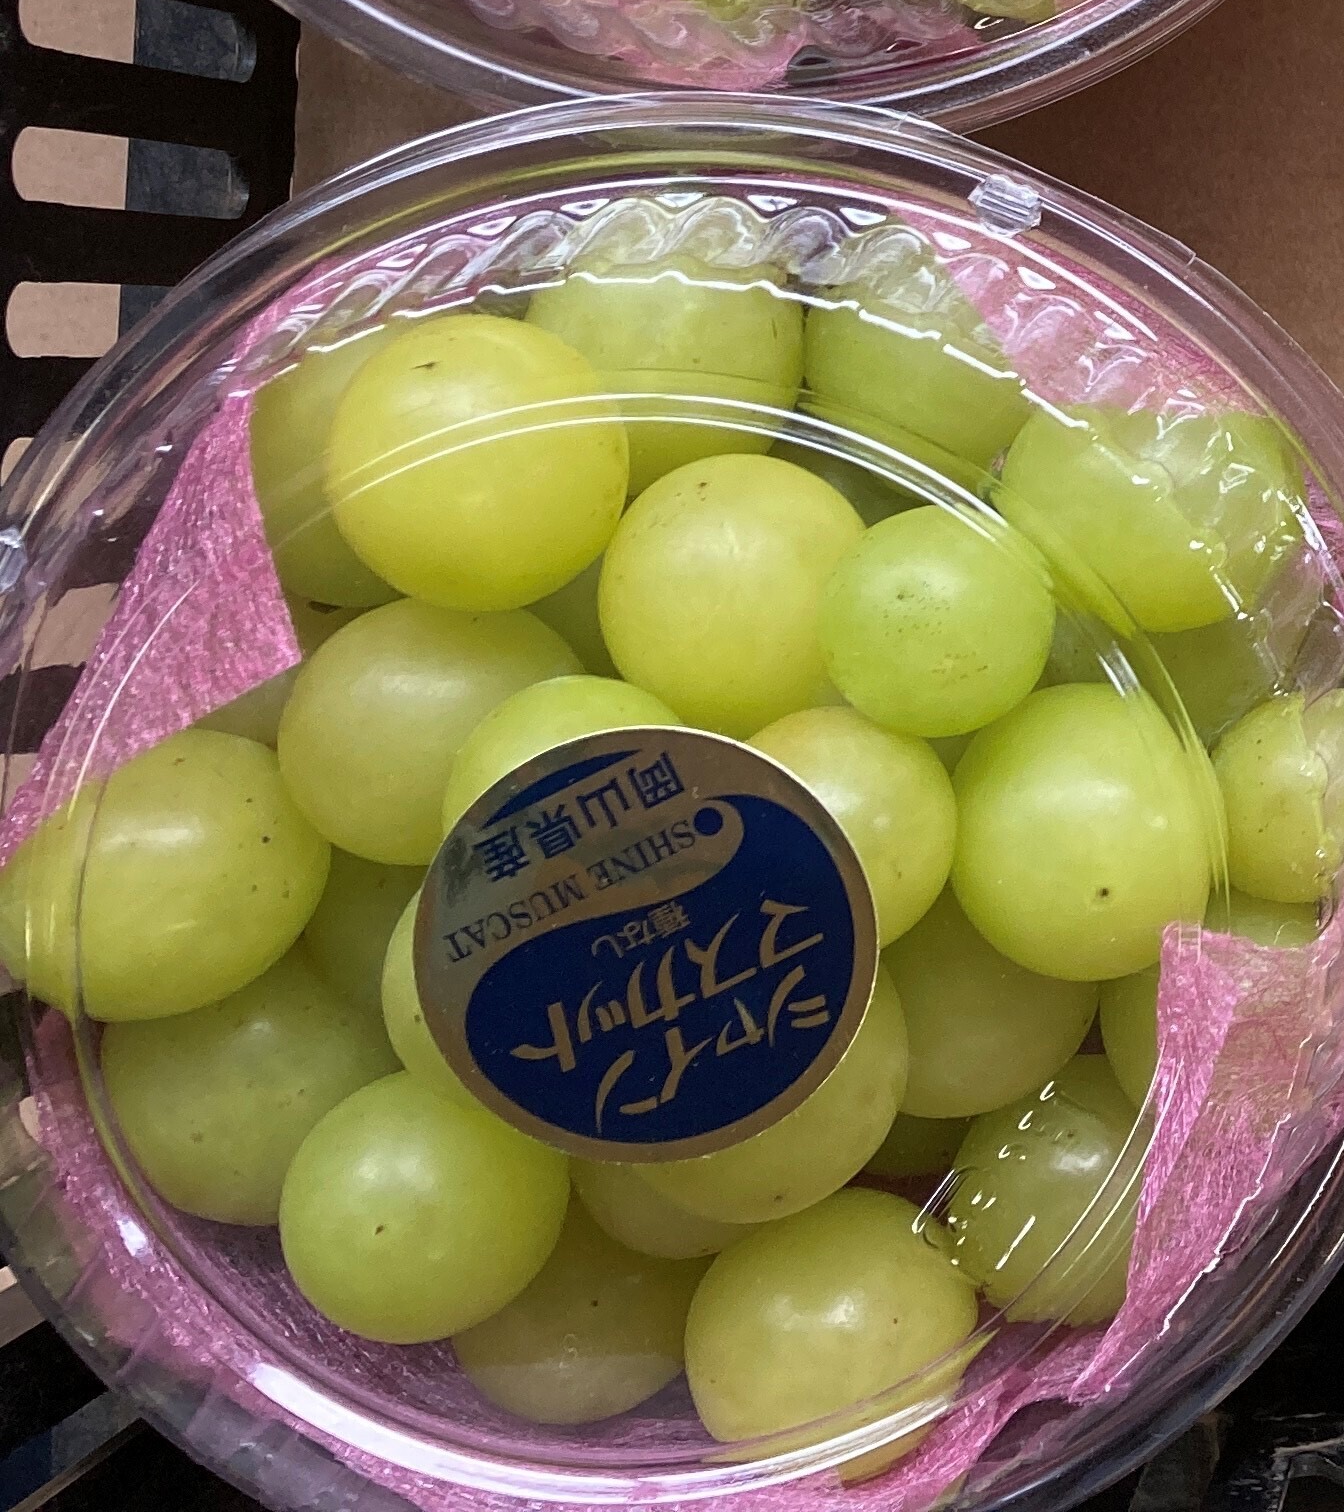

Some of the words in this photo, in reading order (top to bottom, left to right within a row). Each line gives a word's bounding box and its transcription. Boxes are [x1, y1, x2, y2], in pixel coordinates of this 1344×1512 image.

[472, 751, 685, 883] 岡山県産
[587, 819, 696, 890] SHINE
[442, 872, 588, 964] MUSCAT
[591, 901, 692, 959] 種なし
[510, 899, 824, 1073] マスカット
[594, 965, 830, 1133] シャイン
